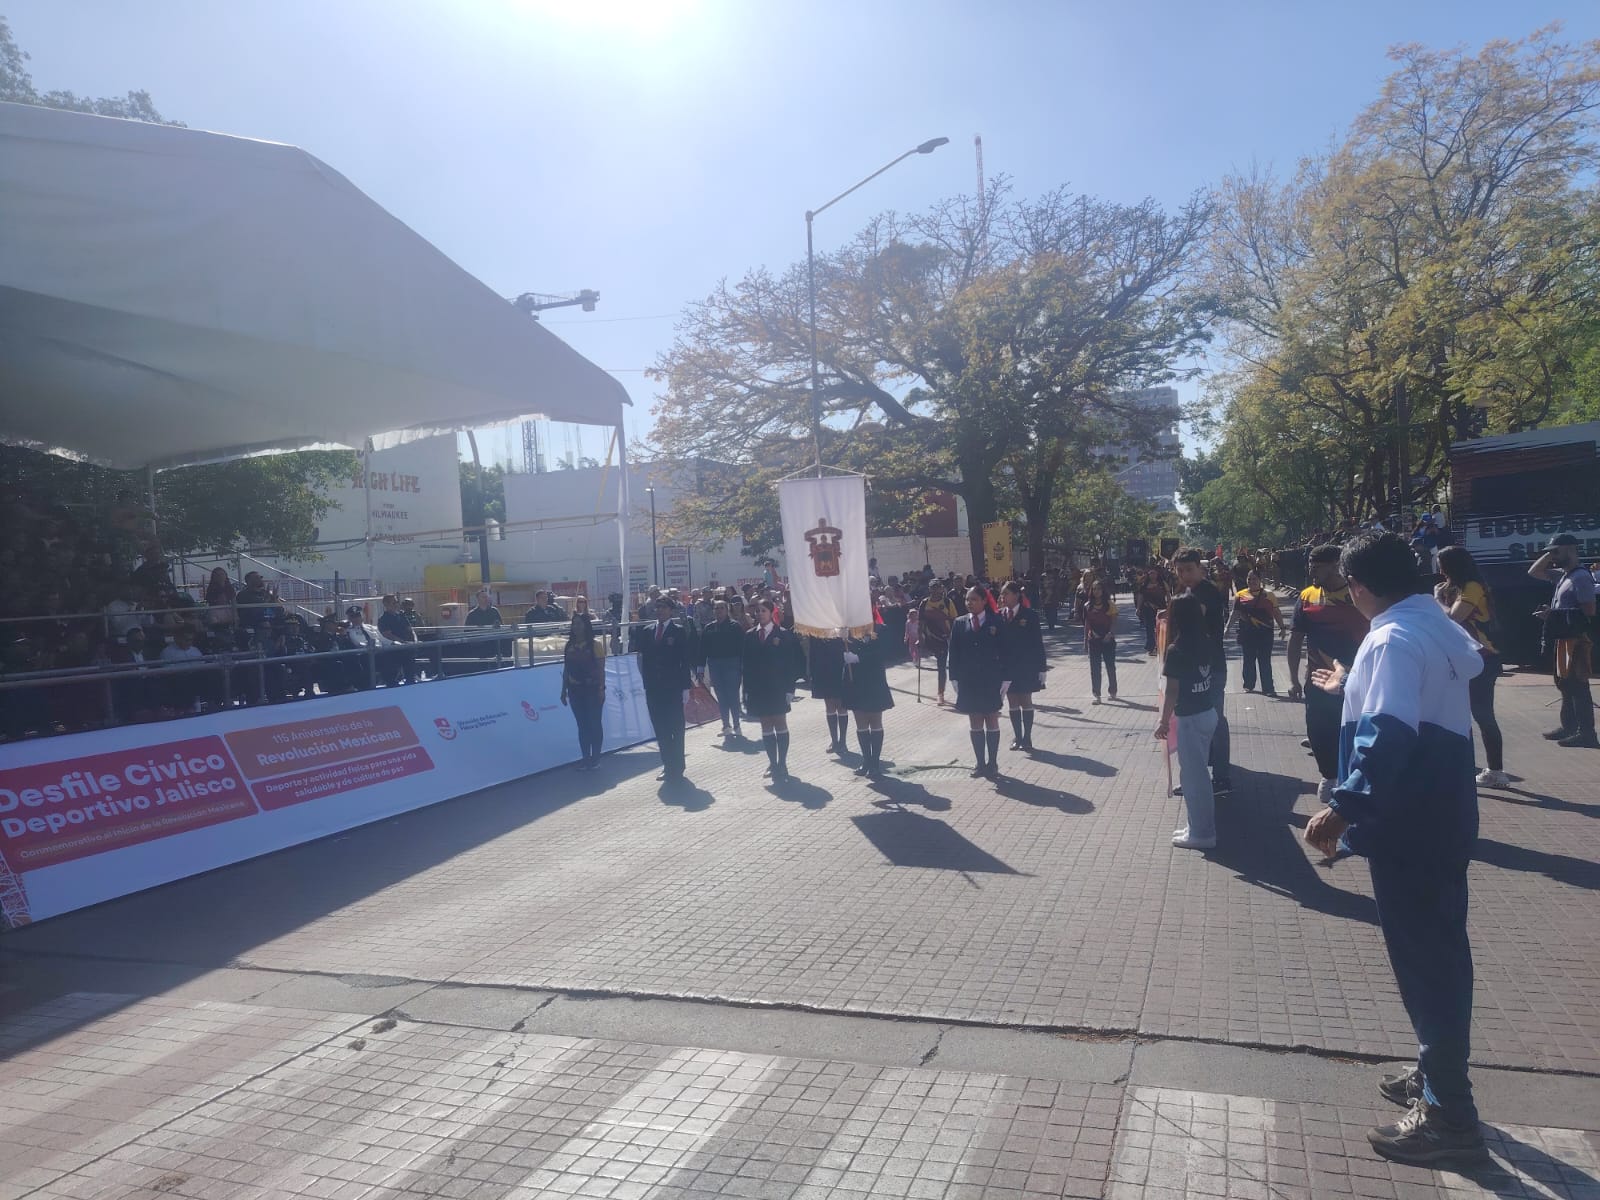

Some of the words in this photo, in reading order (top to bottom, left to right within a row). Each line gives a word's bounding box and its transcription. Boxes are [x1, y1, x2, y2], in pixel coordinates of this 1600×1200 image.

[256, 742, 338, 767] Revolución
[338, 730, 402, 750] Mexicana
[290, 723, 350, 741] Aniversario
[0, 771, 122, 813] Desfile
[265, 779, 303, 794] Deporte
[309, 767, 348, 784] actividad
[1, 795, 151, 839] Deportivo
[154, 777, 237, 806] Jalisco
